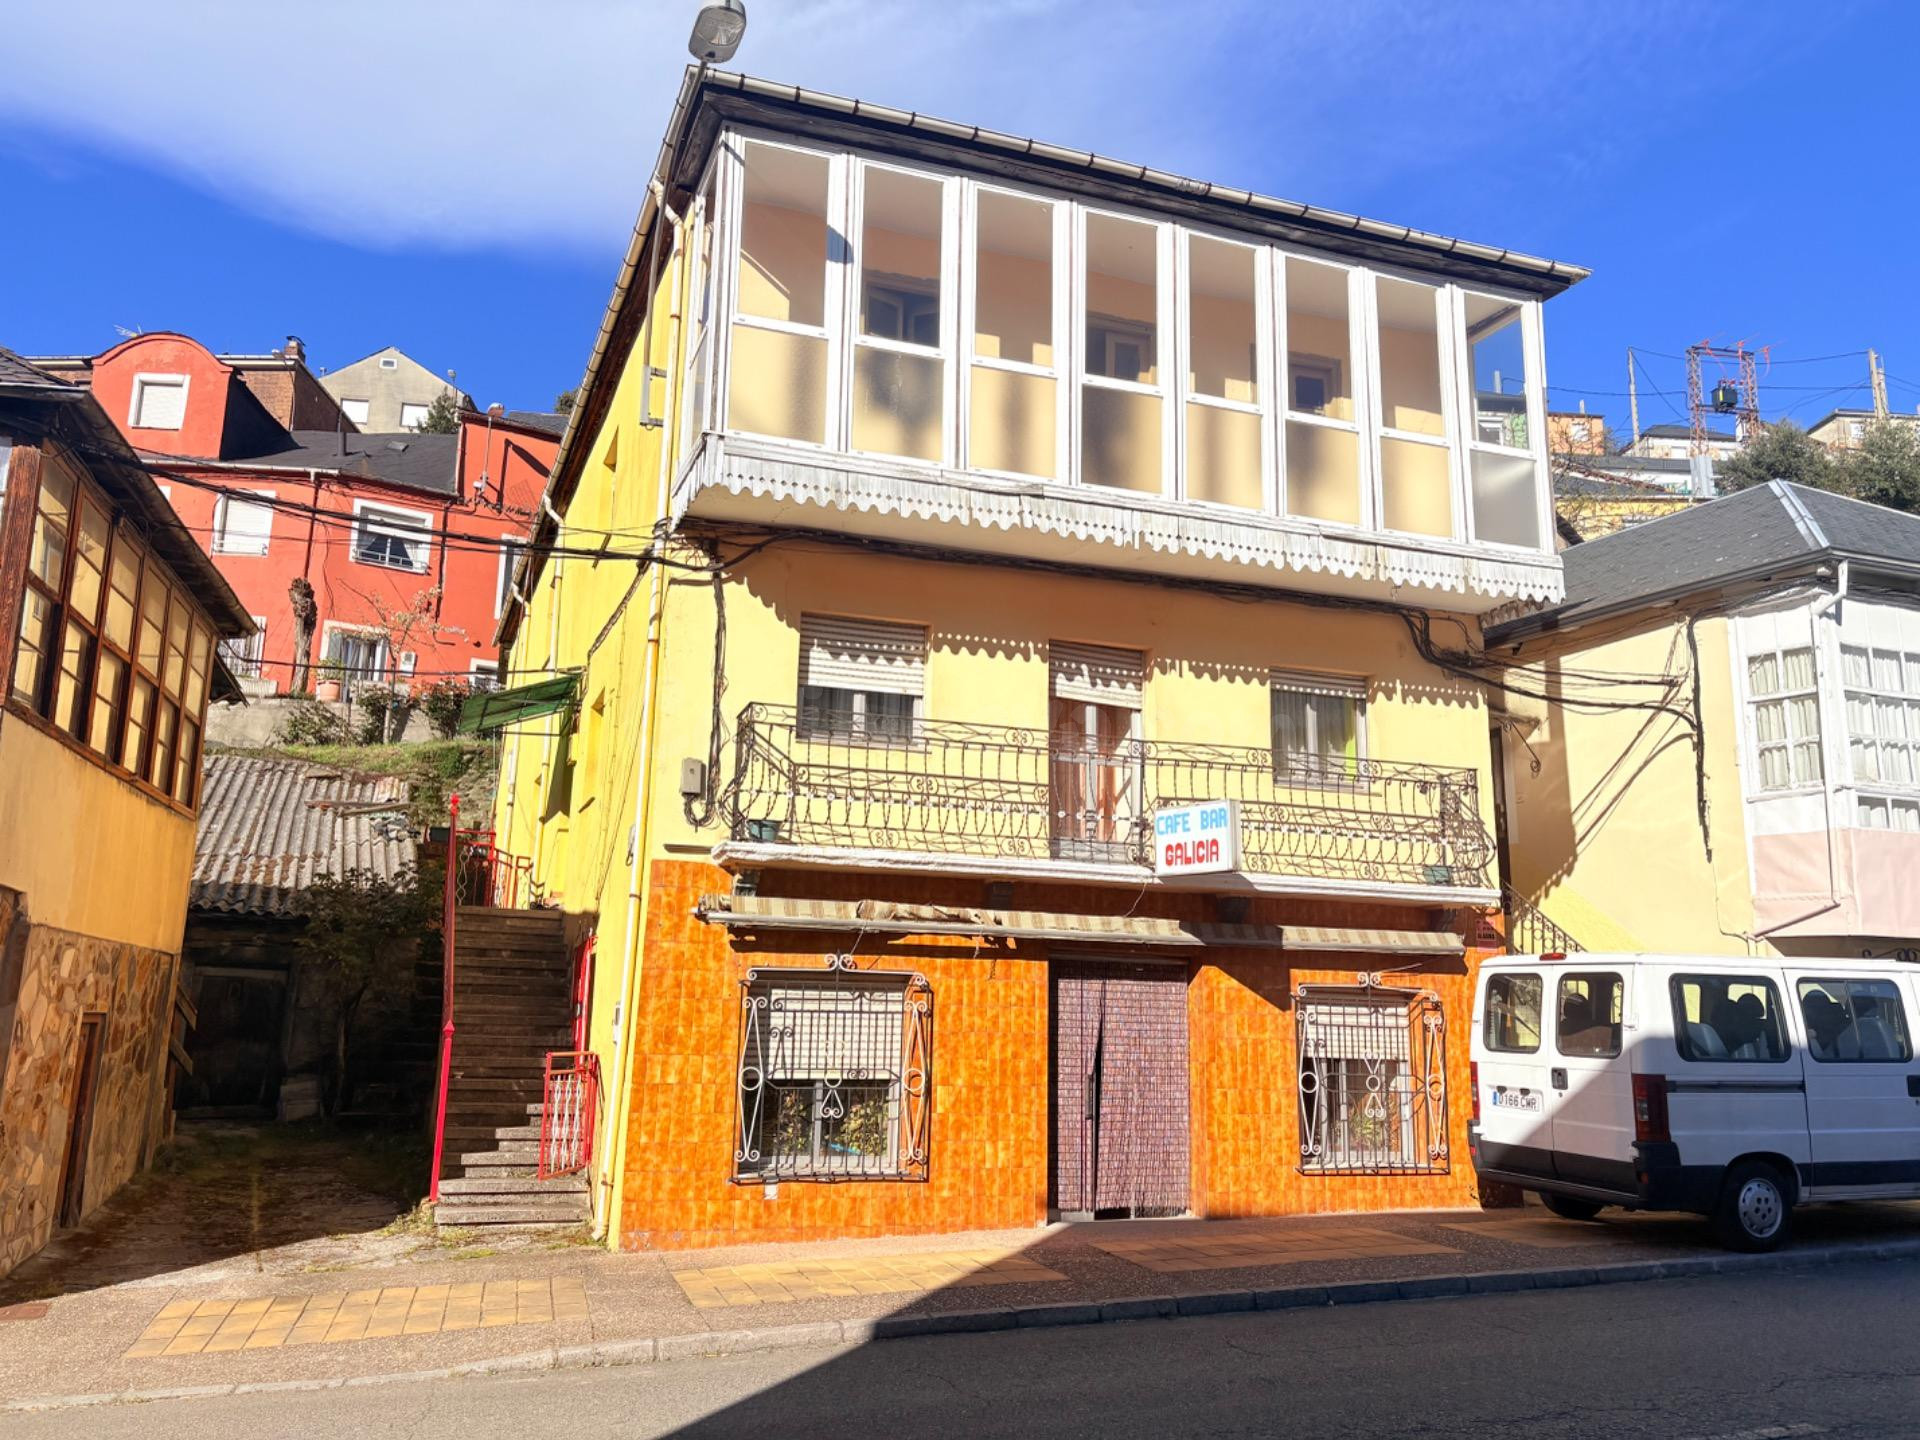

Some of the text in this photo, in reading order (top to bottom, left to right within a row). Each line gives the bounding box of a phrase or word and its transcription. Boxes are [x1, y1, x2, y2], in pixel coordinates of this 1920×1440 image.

[1156, 807, 1227, 835] CAFE BAR
[1165, 838, 1219, 866] GALICIA
